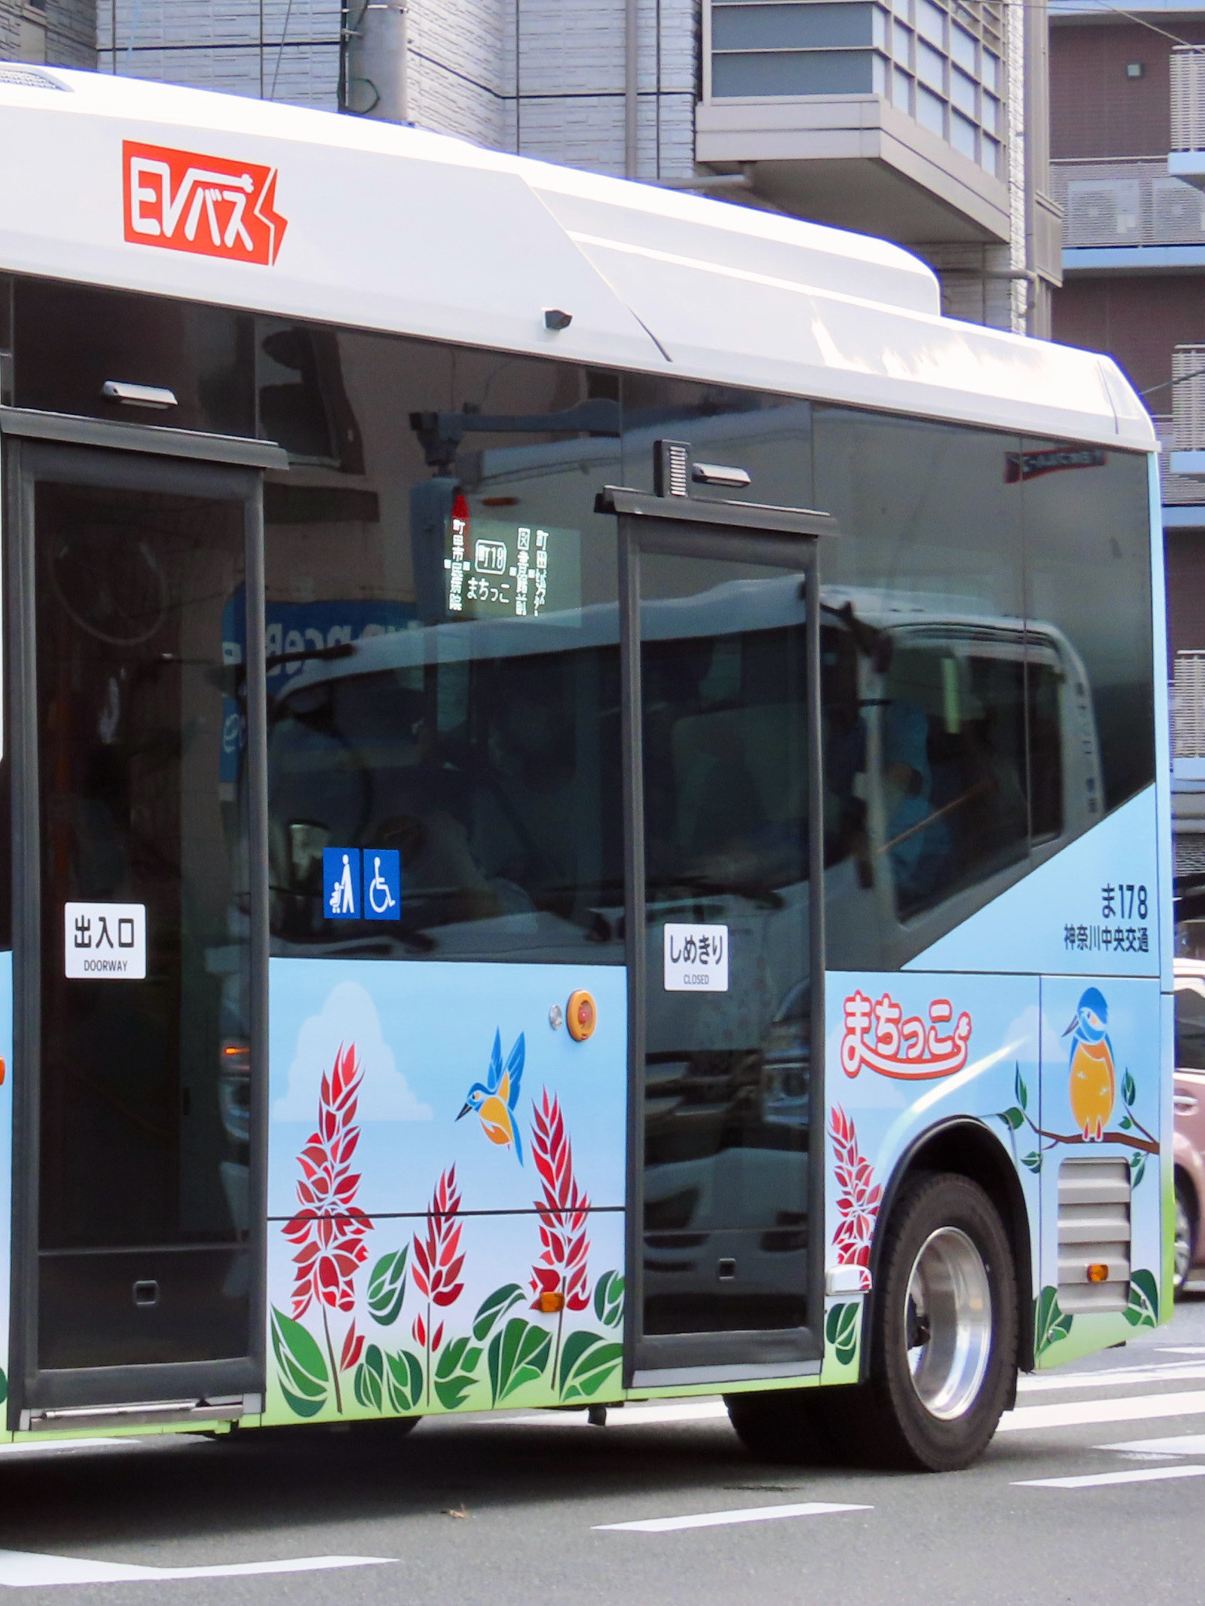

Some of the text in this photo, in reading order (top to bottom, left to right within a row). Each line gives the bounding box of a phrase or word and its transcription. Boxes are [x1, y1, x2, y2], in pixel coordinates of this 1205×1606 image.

[477, 545, 505, 569] 町18
[467, 577, 510, 603] まちっこ
[1100, 883, 1149, 920] ま178
[74, 914, 135, 949] 出入口
[1064, 923, 1150, 953] 神奈川中央交通
[670, 934, 723, 965] しめきり
[83, 959, 128, 972] DOORWAY
[683, 973, 710, 985] CLOSED
[841, 990, 972, 1080] まちっこ
